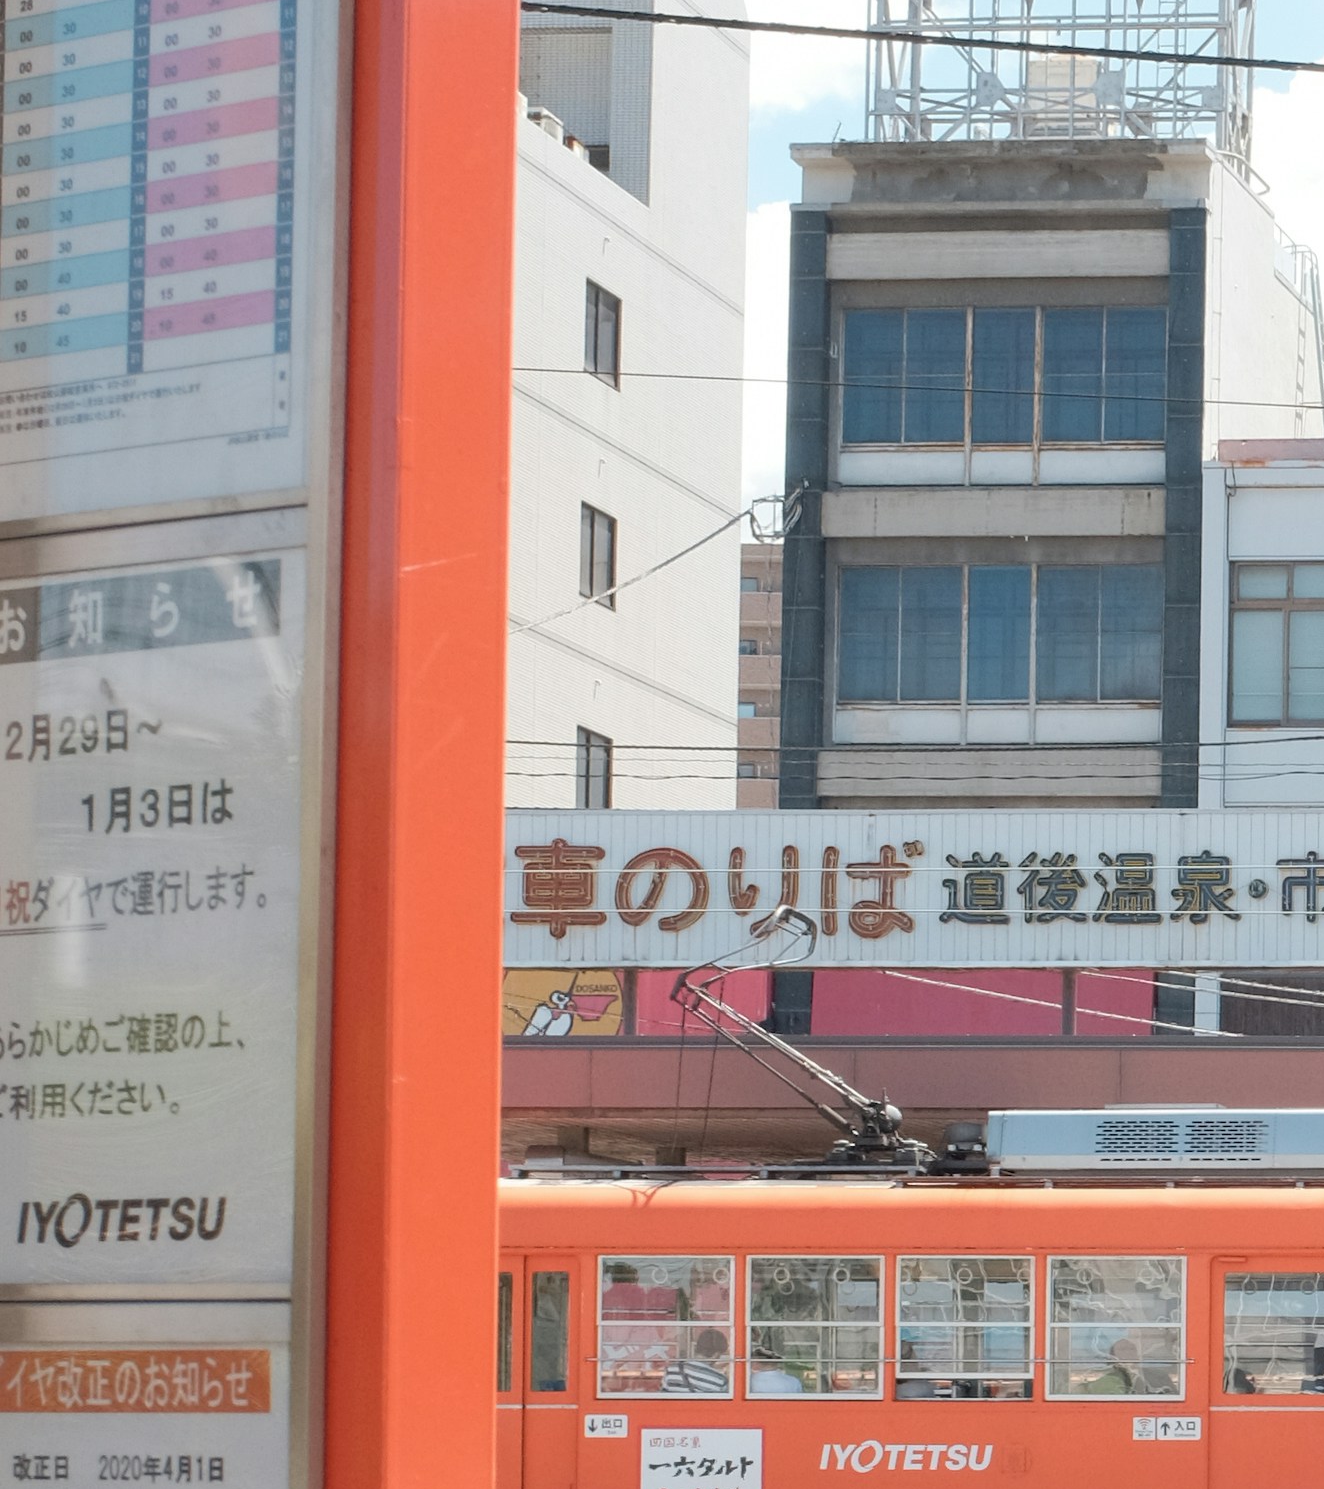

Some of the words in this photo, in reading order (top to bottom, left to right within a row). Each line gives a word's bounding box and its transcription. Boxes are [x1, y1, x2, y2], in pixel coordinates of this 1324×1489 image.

[81, 778, 233, 834] 1月3日は
[575, 984, 618, 993] DOSANKO
[0, 1012, 246, 1060] らかじめご確認の上、
[17, 1193, 227, 1248] IYOTETSU
[0, 1356, 252, 1408] イヤ改正のお知らせ
[602, 1418, 622, 1428] 出口
[1174, 1421, 1195, 1431] 入口
[13, 1454, 69, 1482] 改正日
[98, 1454, 225, 1483] 2020年4月1日
[648, 1456, 754, 1479] 一六タルト
[819, 1439, 994, 1473] IYOTETSU
